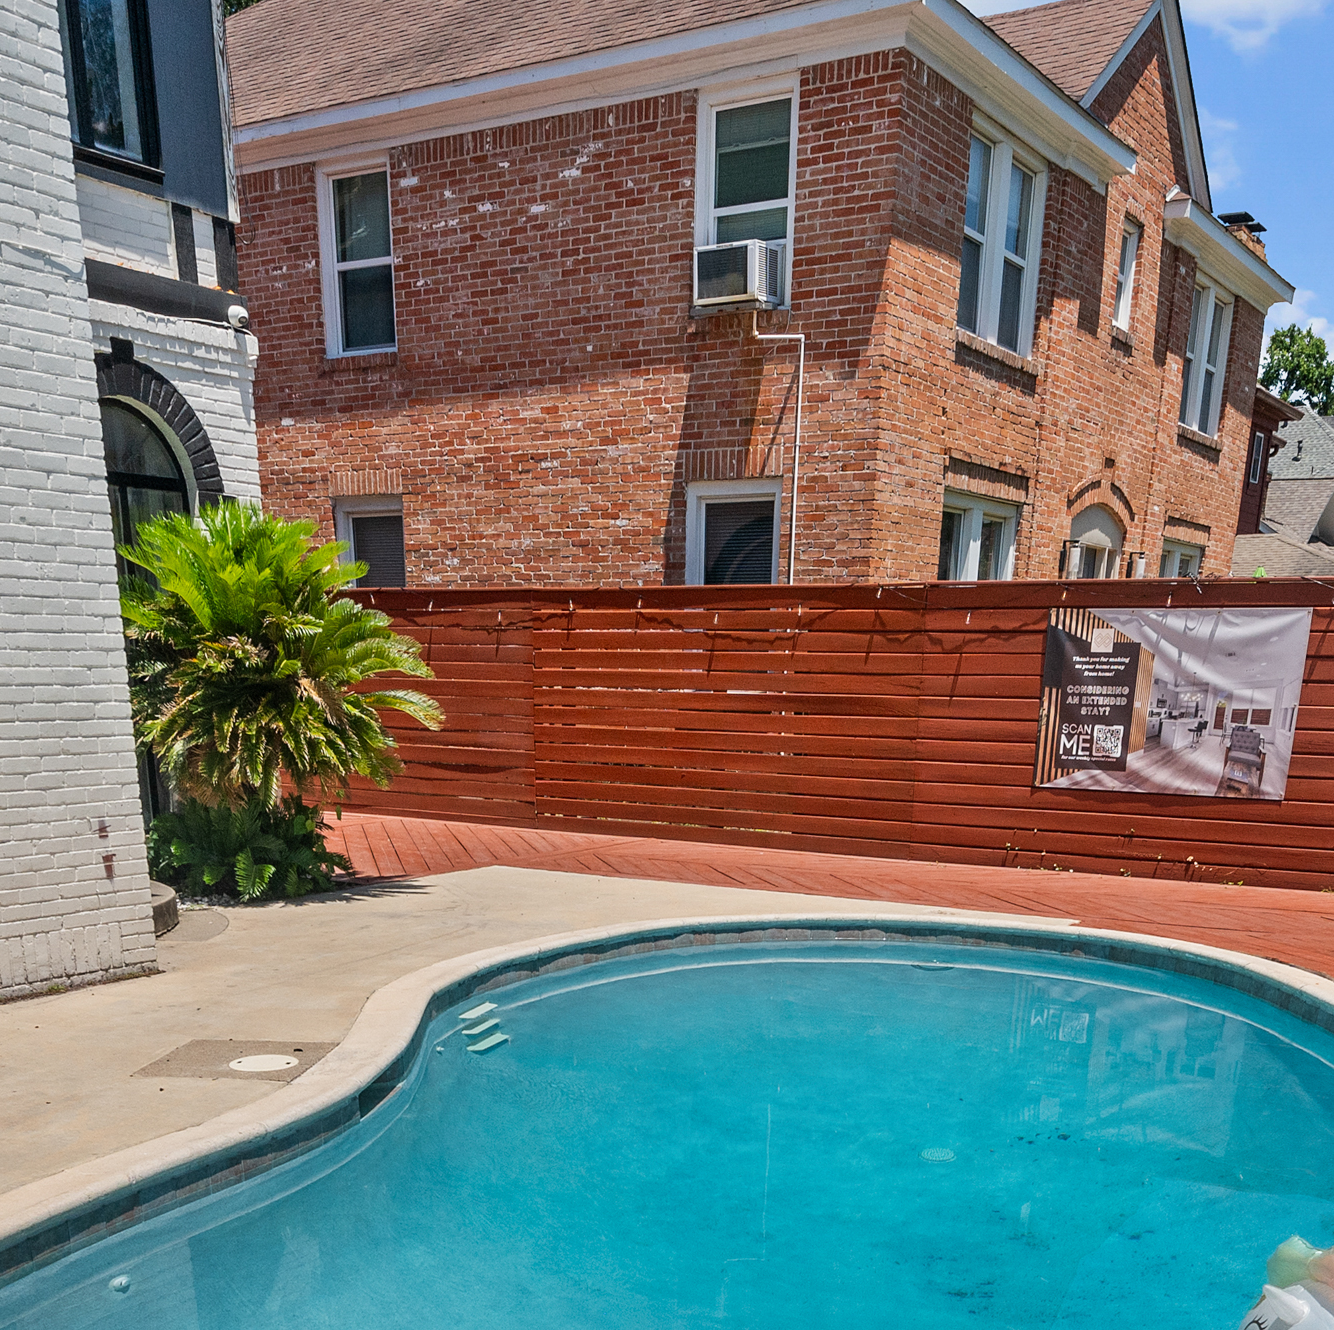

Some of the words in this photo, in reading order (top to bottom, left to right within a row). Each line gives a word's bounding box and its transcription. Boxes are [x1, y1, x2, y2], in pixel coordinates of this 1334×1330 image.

[1066, 685, 1130, 695] CONSIDERING
[1066, 695, 1080, 704] AN
[1081, 696, 1128, 705] EXTENDED
[1080, 707, 1111, 716] STAY?
[1062, 723, 1092, 735] SCAN
[1059, 734, 1091, 756] ME
